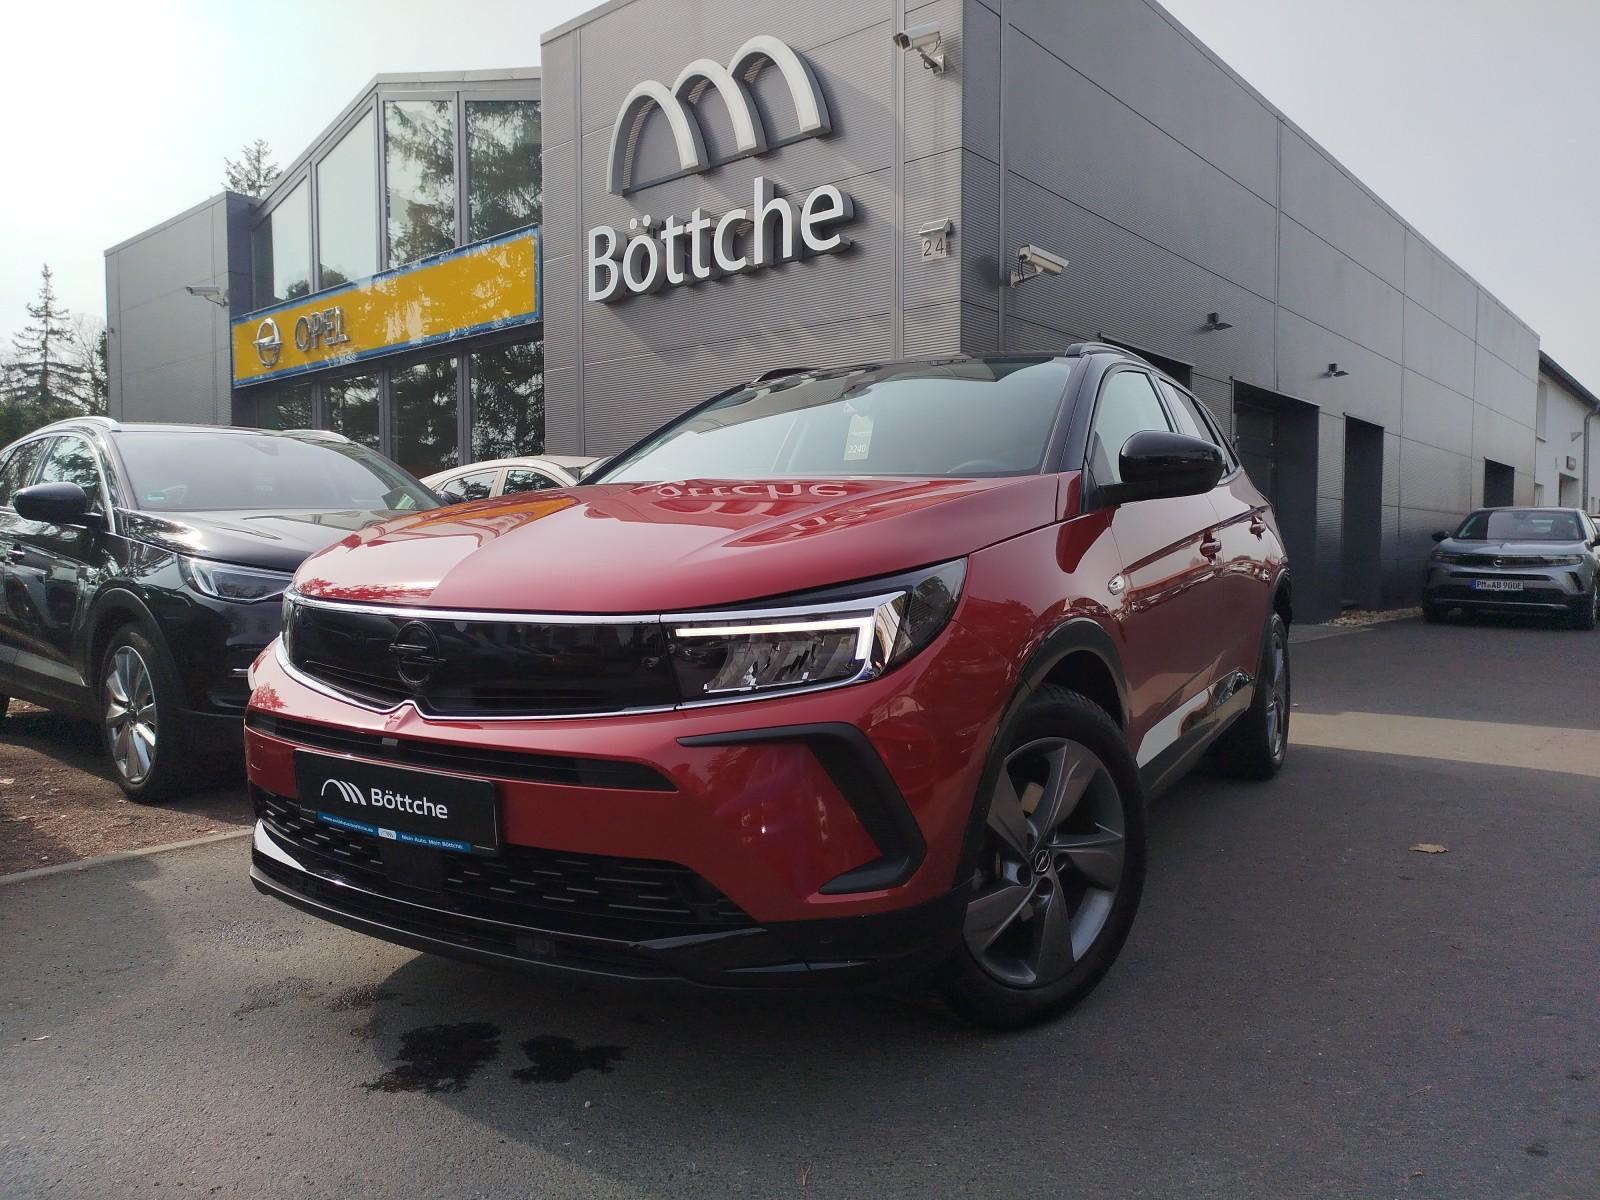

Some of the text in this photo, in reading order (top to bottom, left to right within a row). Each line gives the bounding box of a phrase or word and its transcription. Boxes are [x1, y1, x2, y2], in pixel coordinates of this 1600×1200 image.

[588, 176, 850, 302] Böttche
[923, 237, 945, 257] 24
[295, 306, 349, 352] OPEL
[370, 787, 448, 819] Böttche
